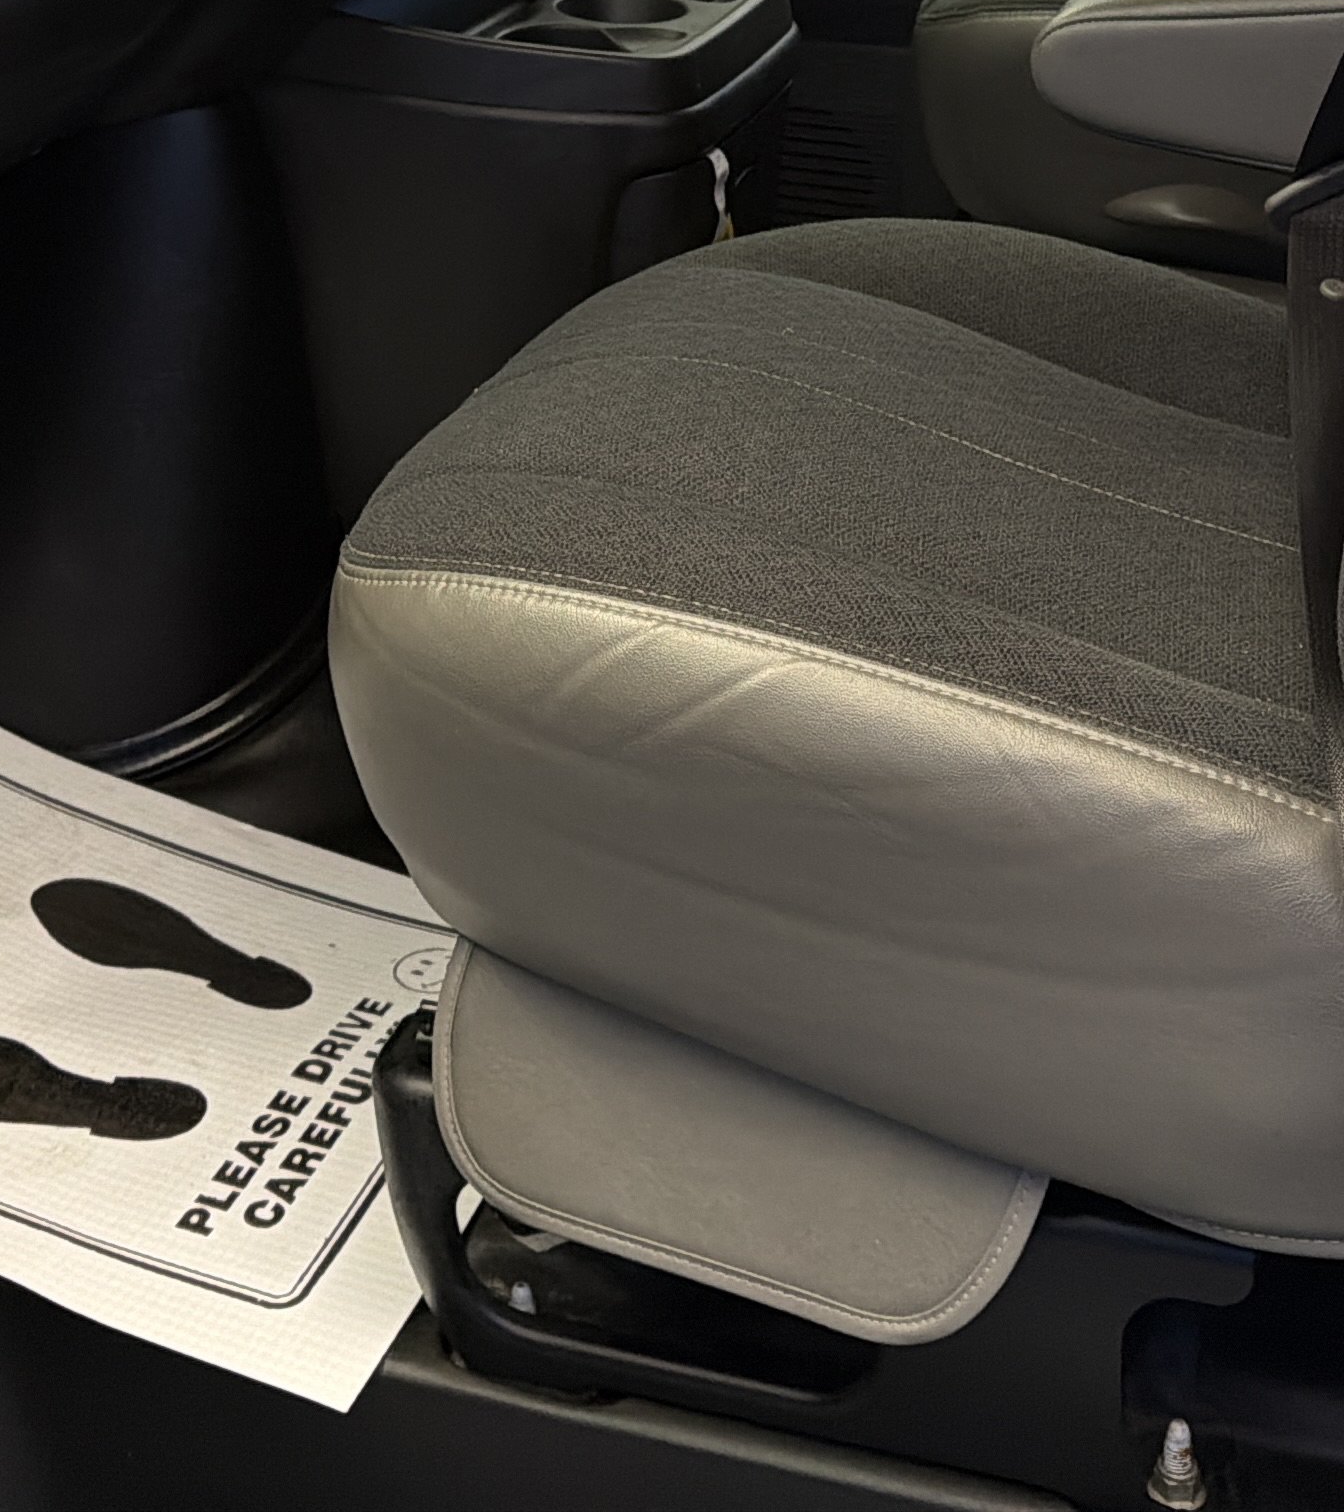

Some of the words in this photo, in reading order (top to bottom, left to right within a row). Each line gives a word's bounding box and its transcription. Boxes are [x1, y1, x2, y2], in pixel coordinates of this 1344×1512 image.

[175, 1089, 312, 1237] PLEASE
[291, 997, 394, 1085] DRIVE
[242, 1020, 400, 1229] CAREFU
